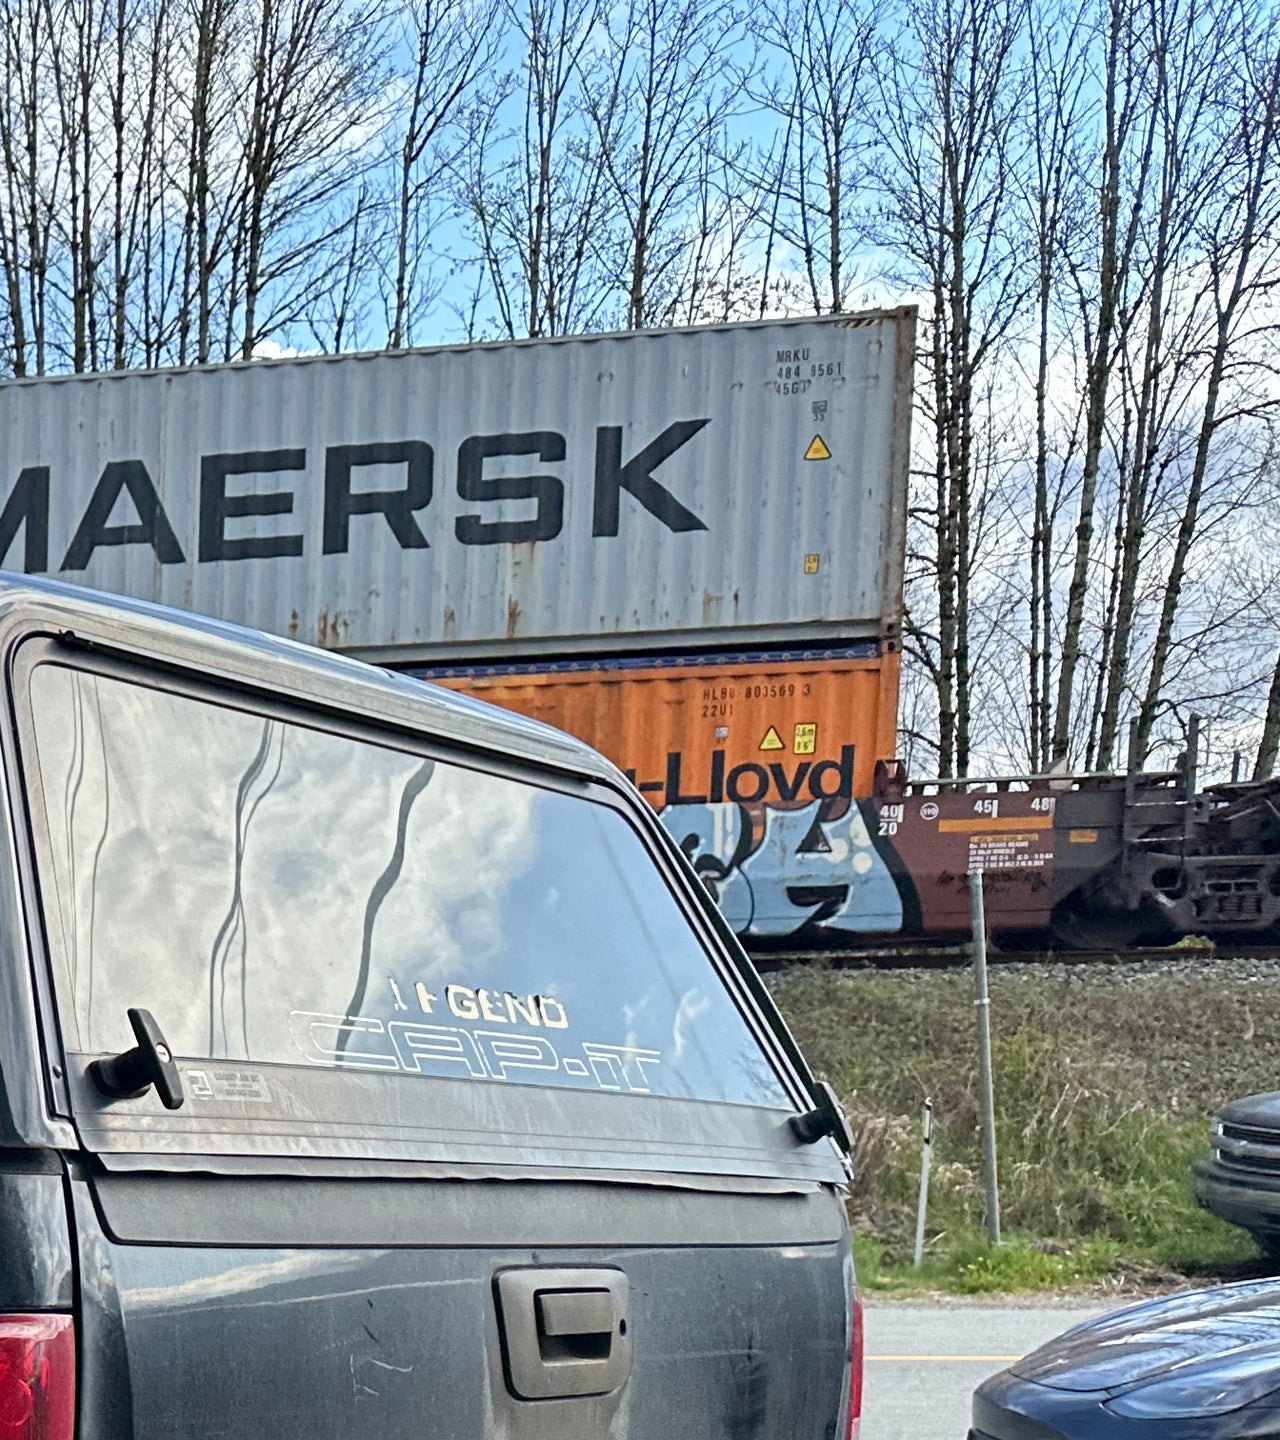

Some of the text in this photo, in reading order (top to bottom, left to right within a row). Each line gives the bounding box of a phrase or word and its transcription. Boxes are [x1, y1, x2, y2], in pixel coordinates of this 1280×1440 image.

[776, 347, 810, 363] MRKU
[777, 365, 801, 380] 484
[744, 684, 795, 699] 803569
[802, 683, 811, 697] 3
[880, 803, 899, 818] 40
[973, 800, 993, 813] 45
[1030, 797, 1050, 811] 48
[878, 822, 898, 836] 20
